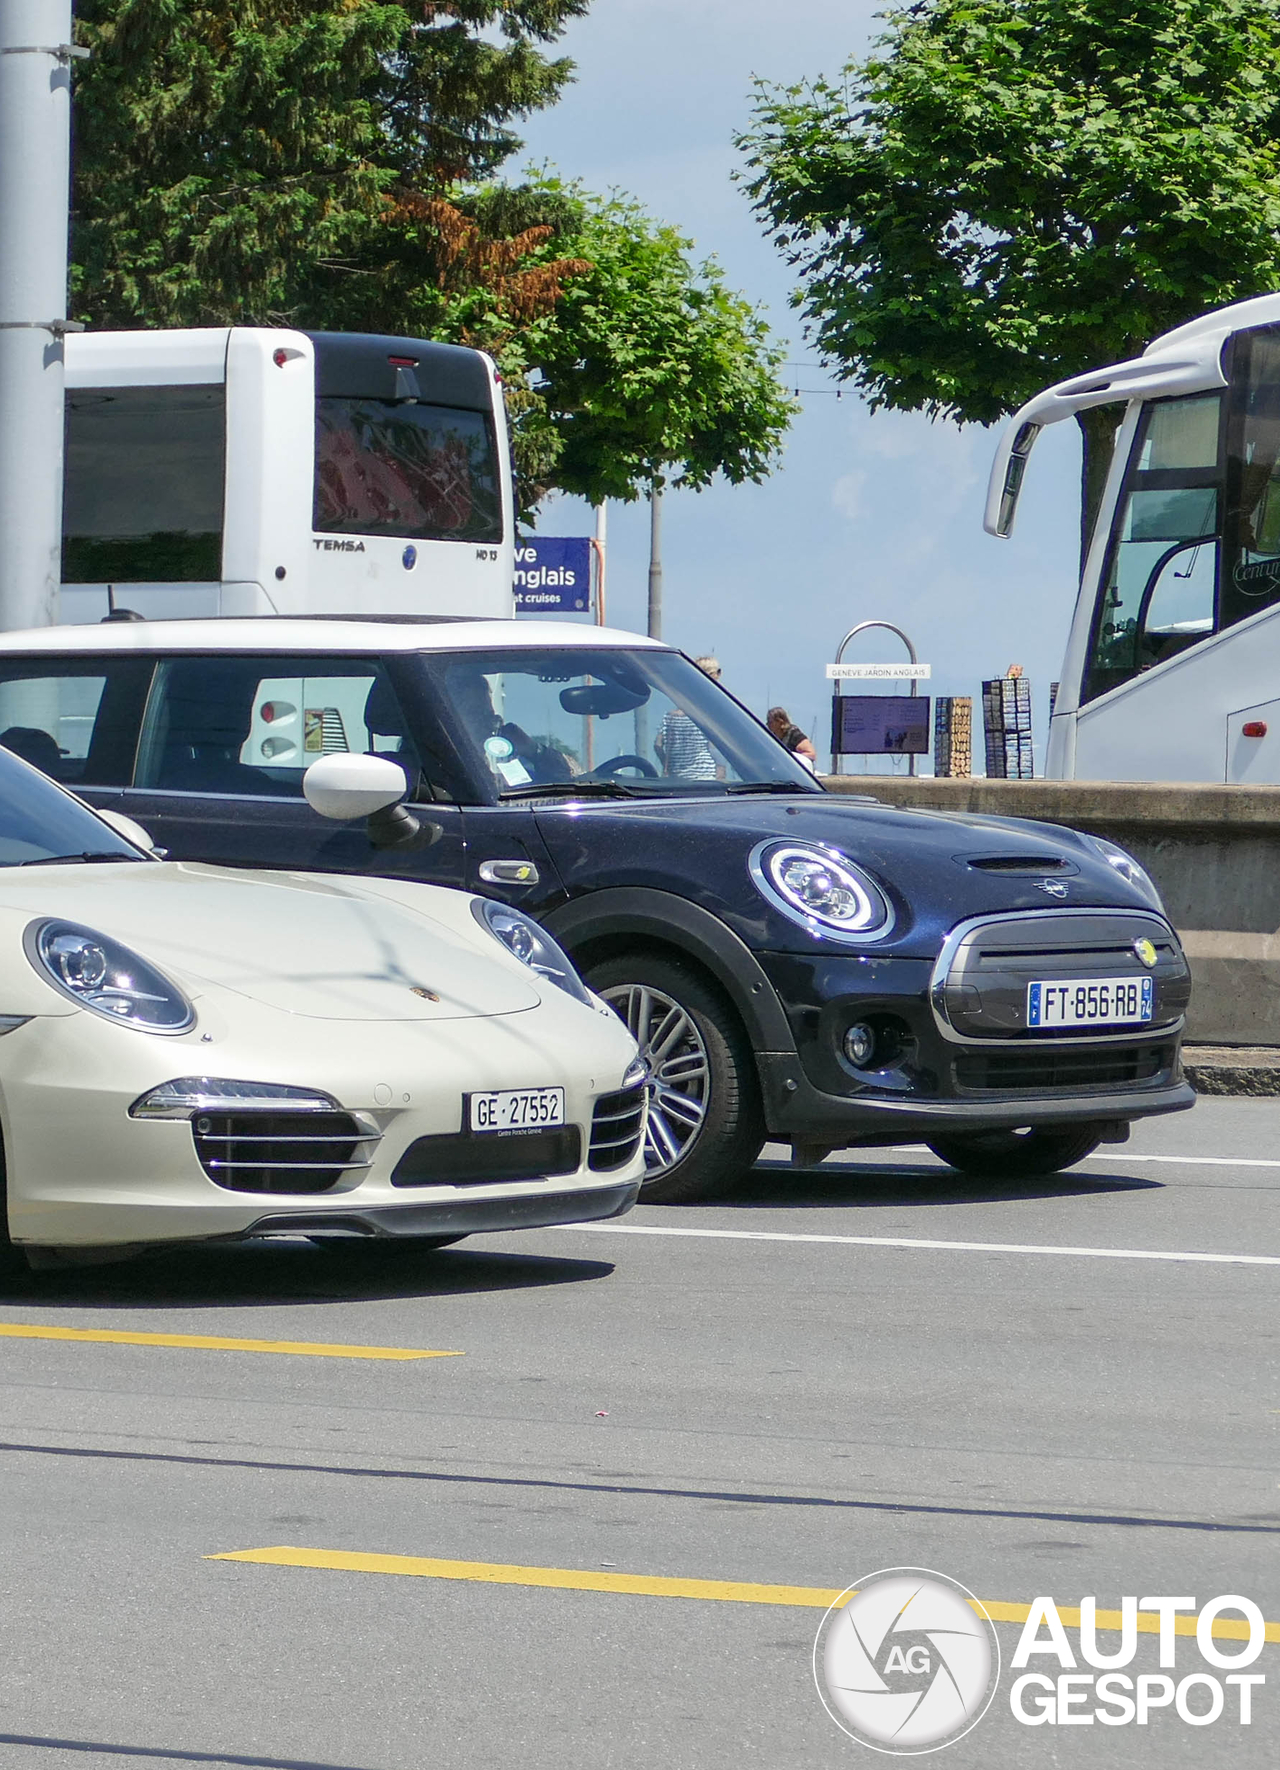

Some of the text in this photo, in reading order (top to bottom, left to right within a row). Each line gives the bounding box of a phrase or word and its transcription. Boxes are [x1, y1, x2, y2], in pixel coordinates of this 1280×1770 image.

[312, 538, 366, 553] TEMSA
[525, 593, 561, 603] cruises
[864, 669, 891, 677] JARDIN
[894, 668, 926, 676] ANGLAIS
